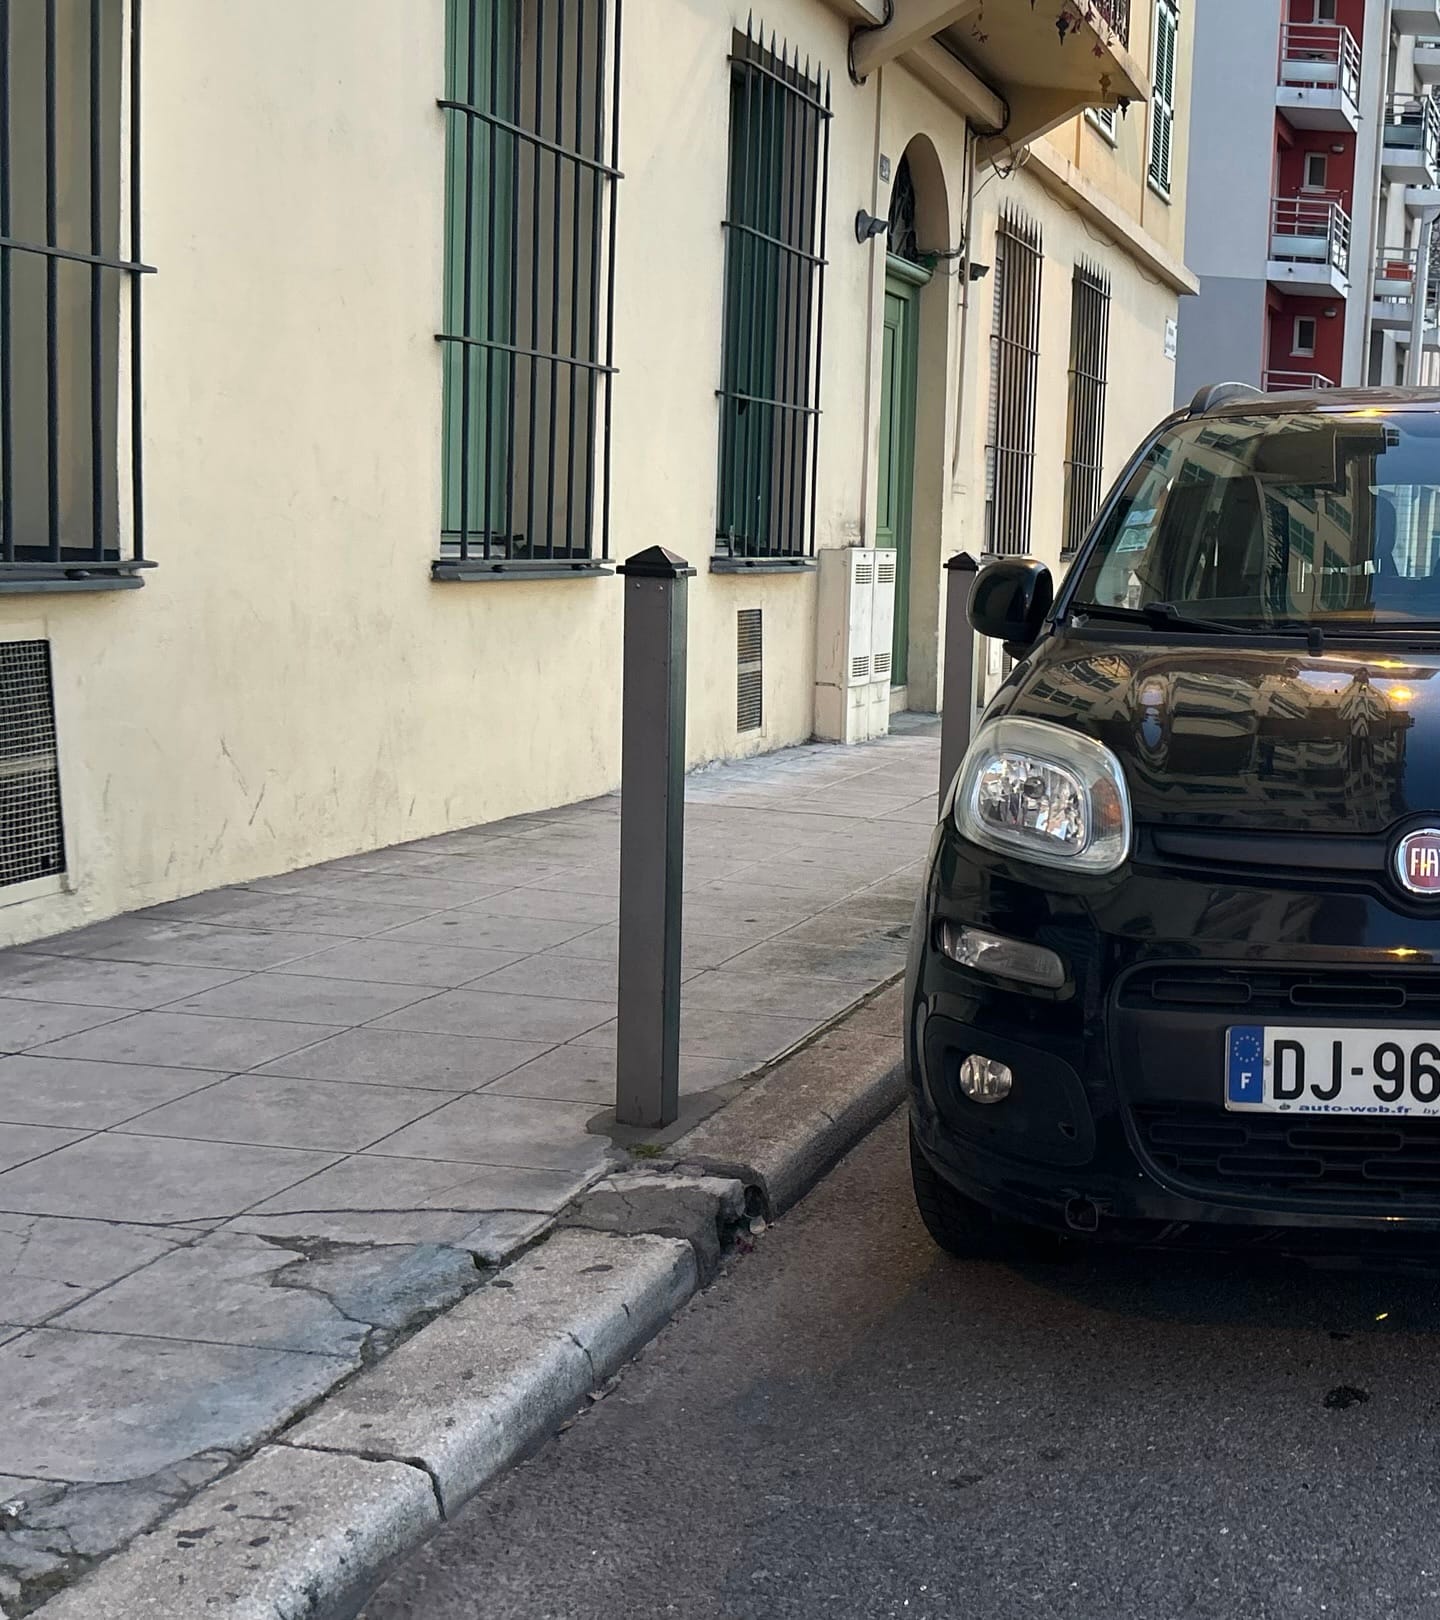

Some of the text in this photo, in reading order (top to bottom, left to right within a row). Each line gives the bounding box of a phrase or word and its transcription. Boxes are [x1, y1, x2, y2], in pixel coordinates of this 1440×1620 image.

[1240, 1072, 1252, 1089] F
[1299, 1104, 1412, 1114] auto-web.fr
[1423, 1108, 1439, 1116] by
